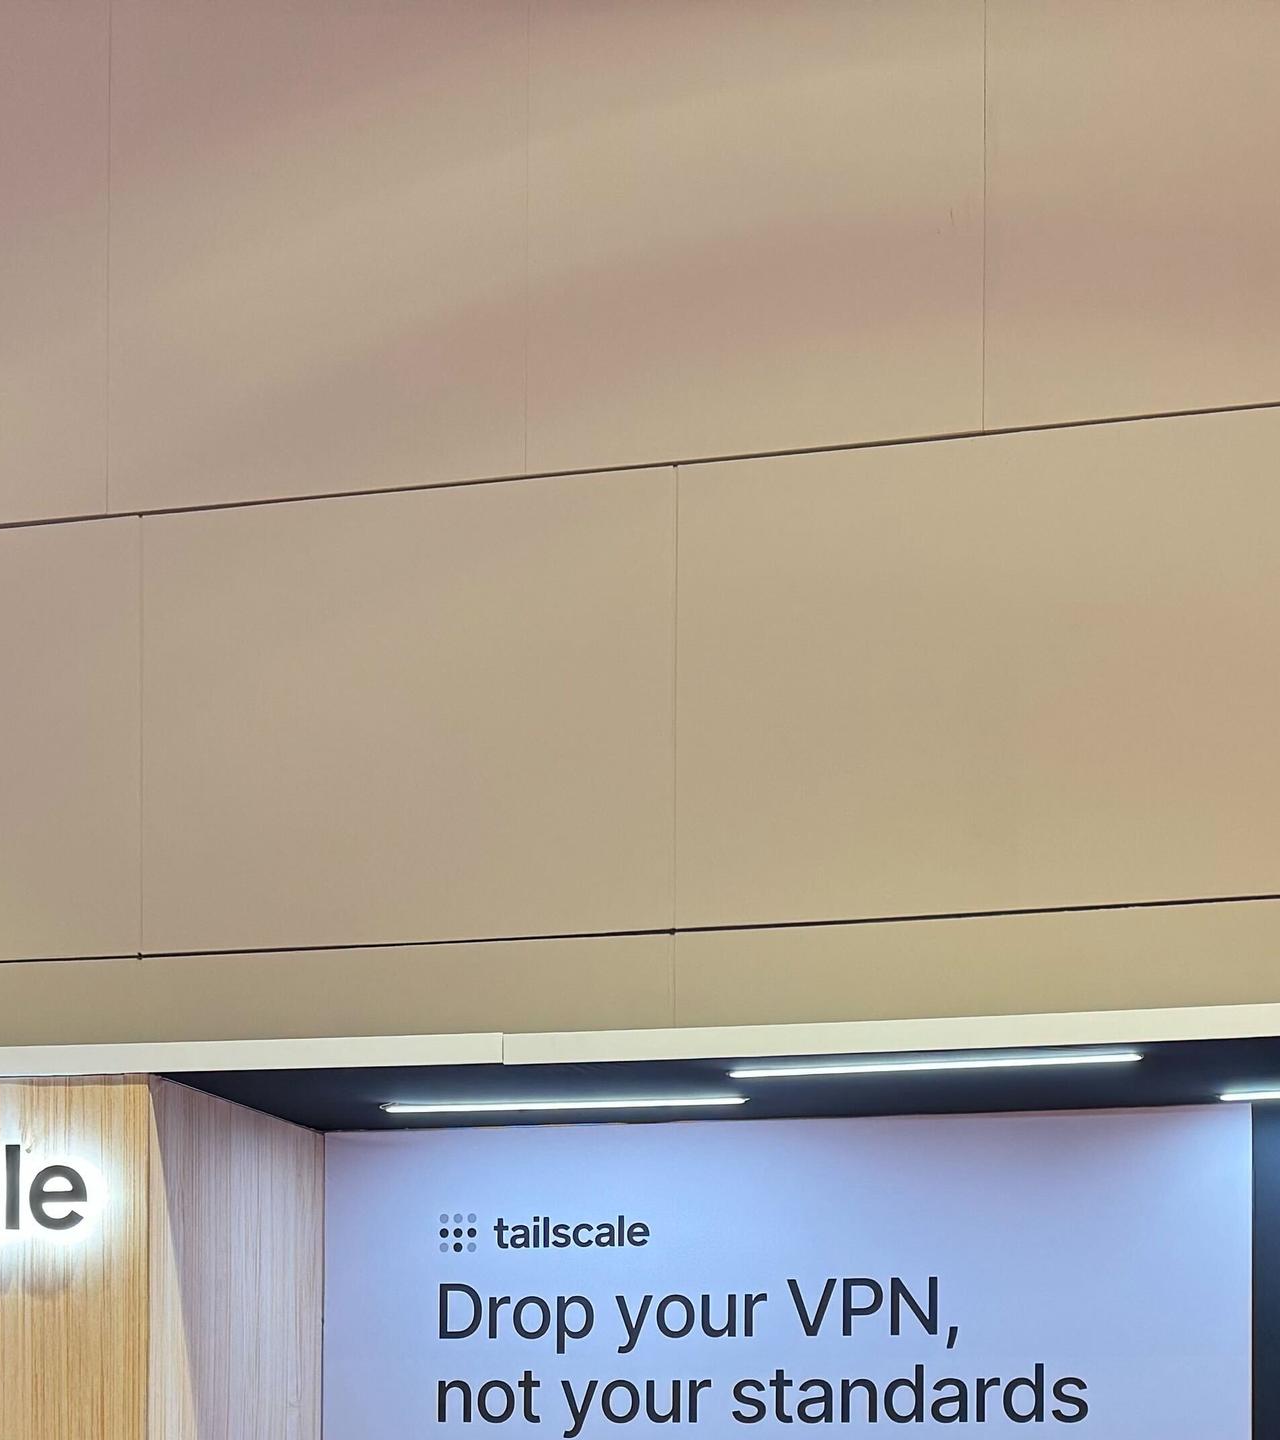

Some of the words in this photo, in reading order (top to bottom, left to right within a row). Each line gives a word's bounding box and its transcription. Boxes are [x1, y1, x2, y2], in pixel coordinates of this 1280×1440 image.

[494, 1216, 650, 1249] tailscale
[438, 1283, 595, 1354] Drop
[615, 1290, 768, 1354] your
[786, 1277, 960, 1349] VPN,
[437, 1370, 541, 1423] not
[561, 1378, 712, 1438] your
[731, 1364, 1090, 1424] standards
